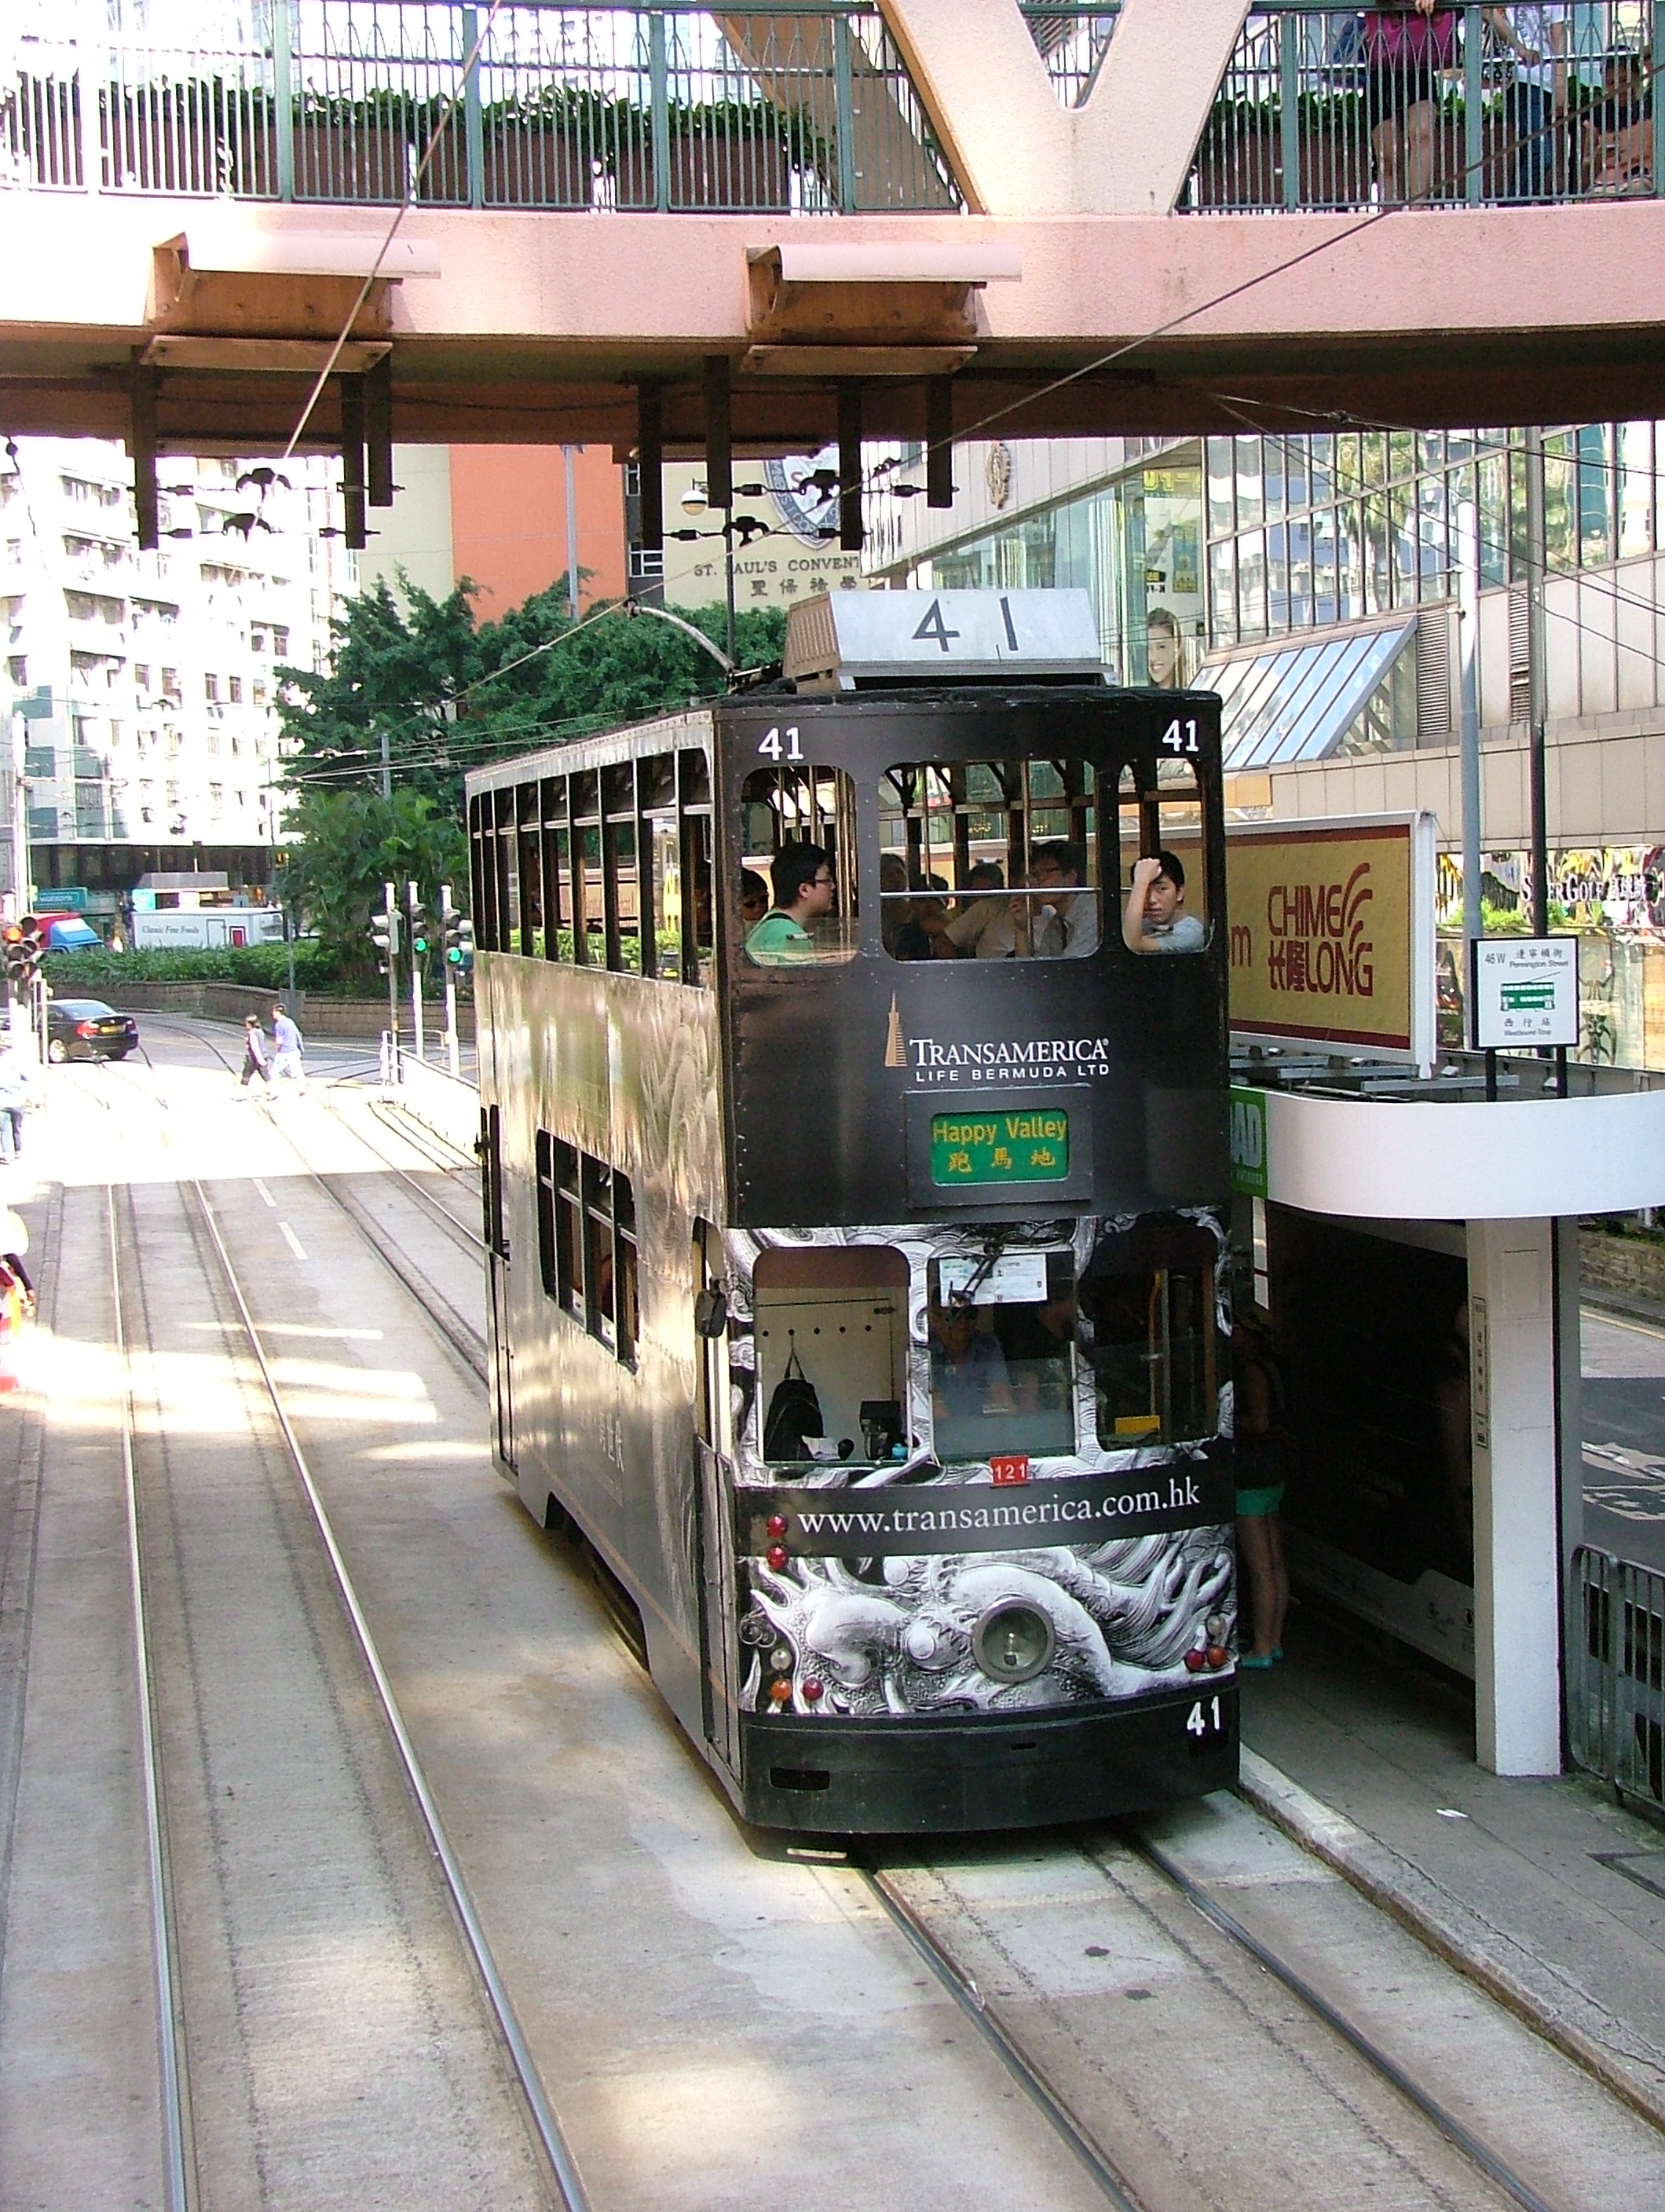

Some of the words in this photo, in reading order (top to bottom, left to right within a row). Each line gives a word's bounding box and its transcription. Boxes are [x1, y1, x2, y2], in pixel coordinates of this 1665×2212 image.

[724, 560, 777, 575] AUL'S
[913, 597, 1019, 652] 41
[758, 727, 804, 760] 41
[1162, 720, 1199, 753] 41
[1509, 960, 1546, 969] Pennington
[1548, 959, 1569, 968] Street
[916, 1069, 960, 1082] LIFE
[972, 1065, 1067, 1081] BERMUDA
[1077, 1064, 1110, 1076] LTD
[933, 1121, 997, 1146] Happy
[1005, 1115, 1067, 1141] Valley
[947, 1146, 1056, 1174] 跑馬地
[994, 1463, 1025, 1480] 121
[797, 1477, 1201, 1533] www.transamerica.com.hk
[1187, 1695, 1220, 1736] 41
